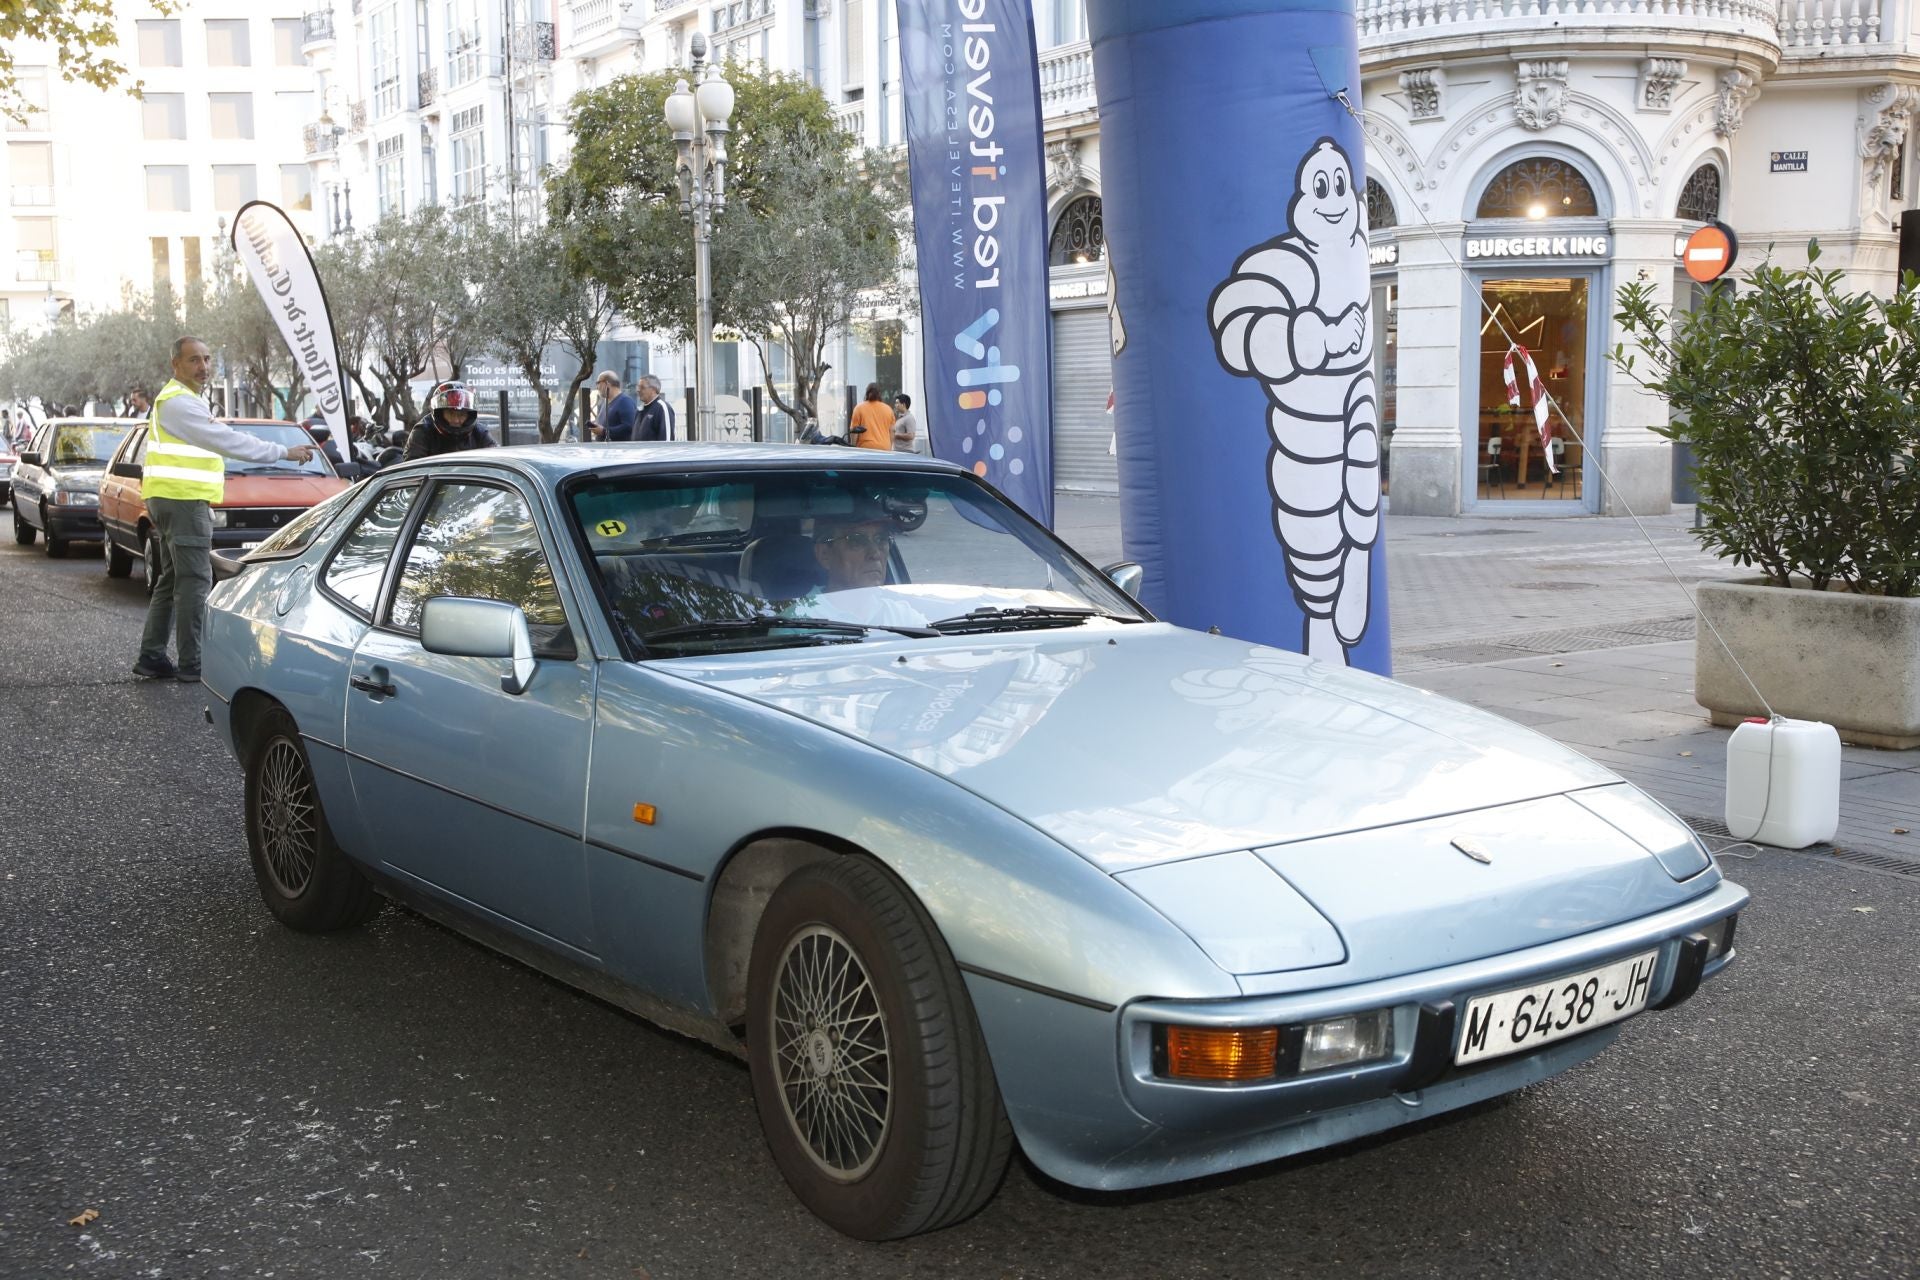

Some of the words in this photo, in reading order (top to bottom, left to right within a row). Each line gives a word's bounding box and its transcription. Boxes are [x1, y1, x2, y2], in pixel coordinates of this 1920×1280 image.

[1783, 152, 1807, 160] CALLE
[1773, 162, 1805, 171] MANTILLA
[1466, 238, 1550, 258] BURGER
[1551, 237, 1608, 255] KING
[465, 364, 492, 375] Todo
[494, 366, 506, 375] es
[466, 376, 506, 386] cuando
[480, 388, 514, 398] miso
[516, 388, 539, 398] idio
[600, 521, 622, 535] H
